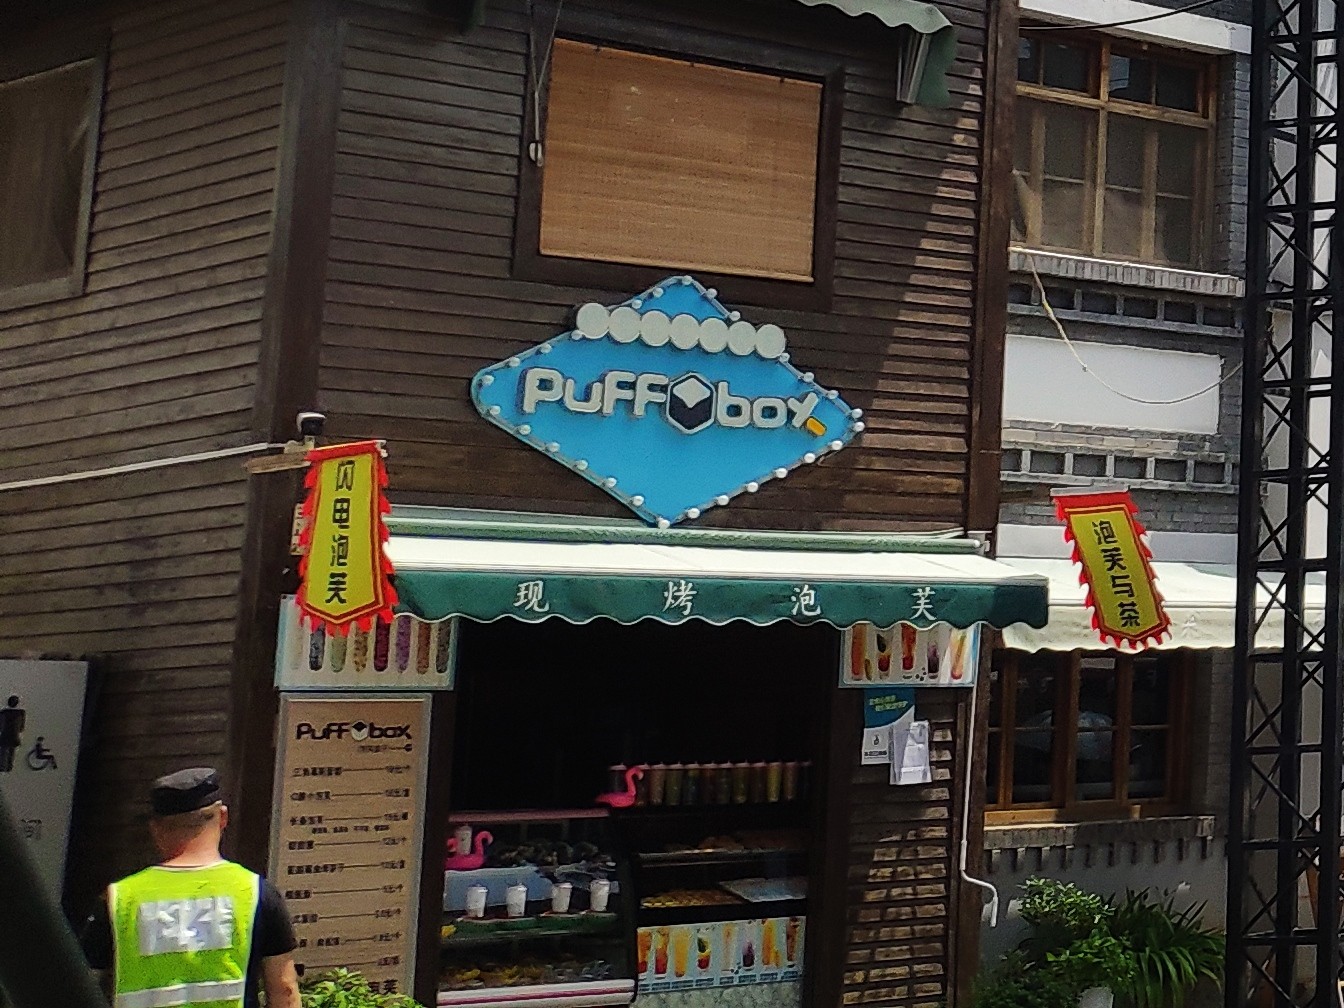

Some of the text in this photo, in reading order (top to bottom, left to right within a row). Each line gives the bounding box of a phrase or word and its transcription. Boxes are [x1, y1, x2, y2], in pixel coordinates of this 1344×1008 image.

[324, 459, 356, 605] 闪电泡芙
[1091, 519, 1141, 628] 泡芙与茶
[512, 579, 937, 622] 现烤泡芙
